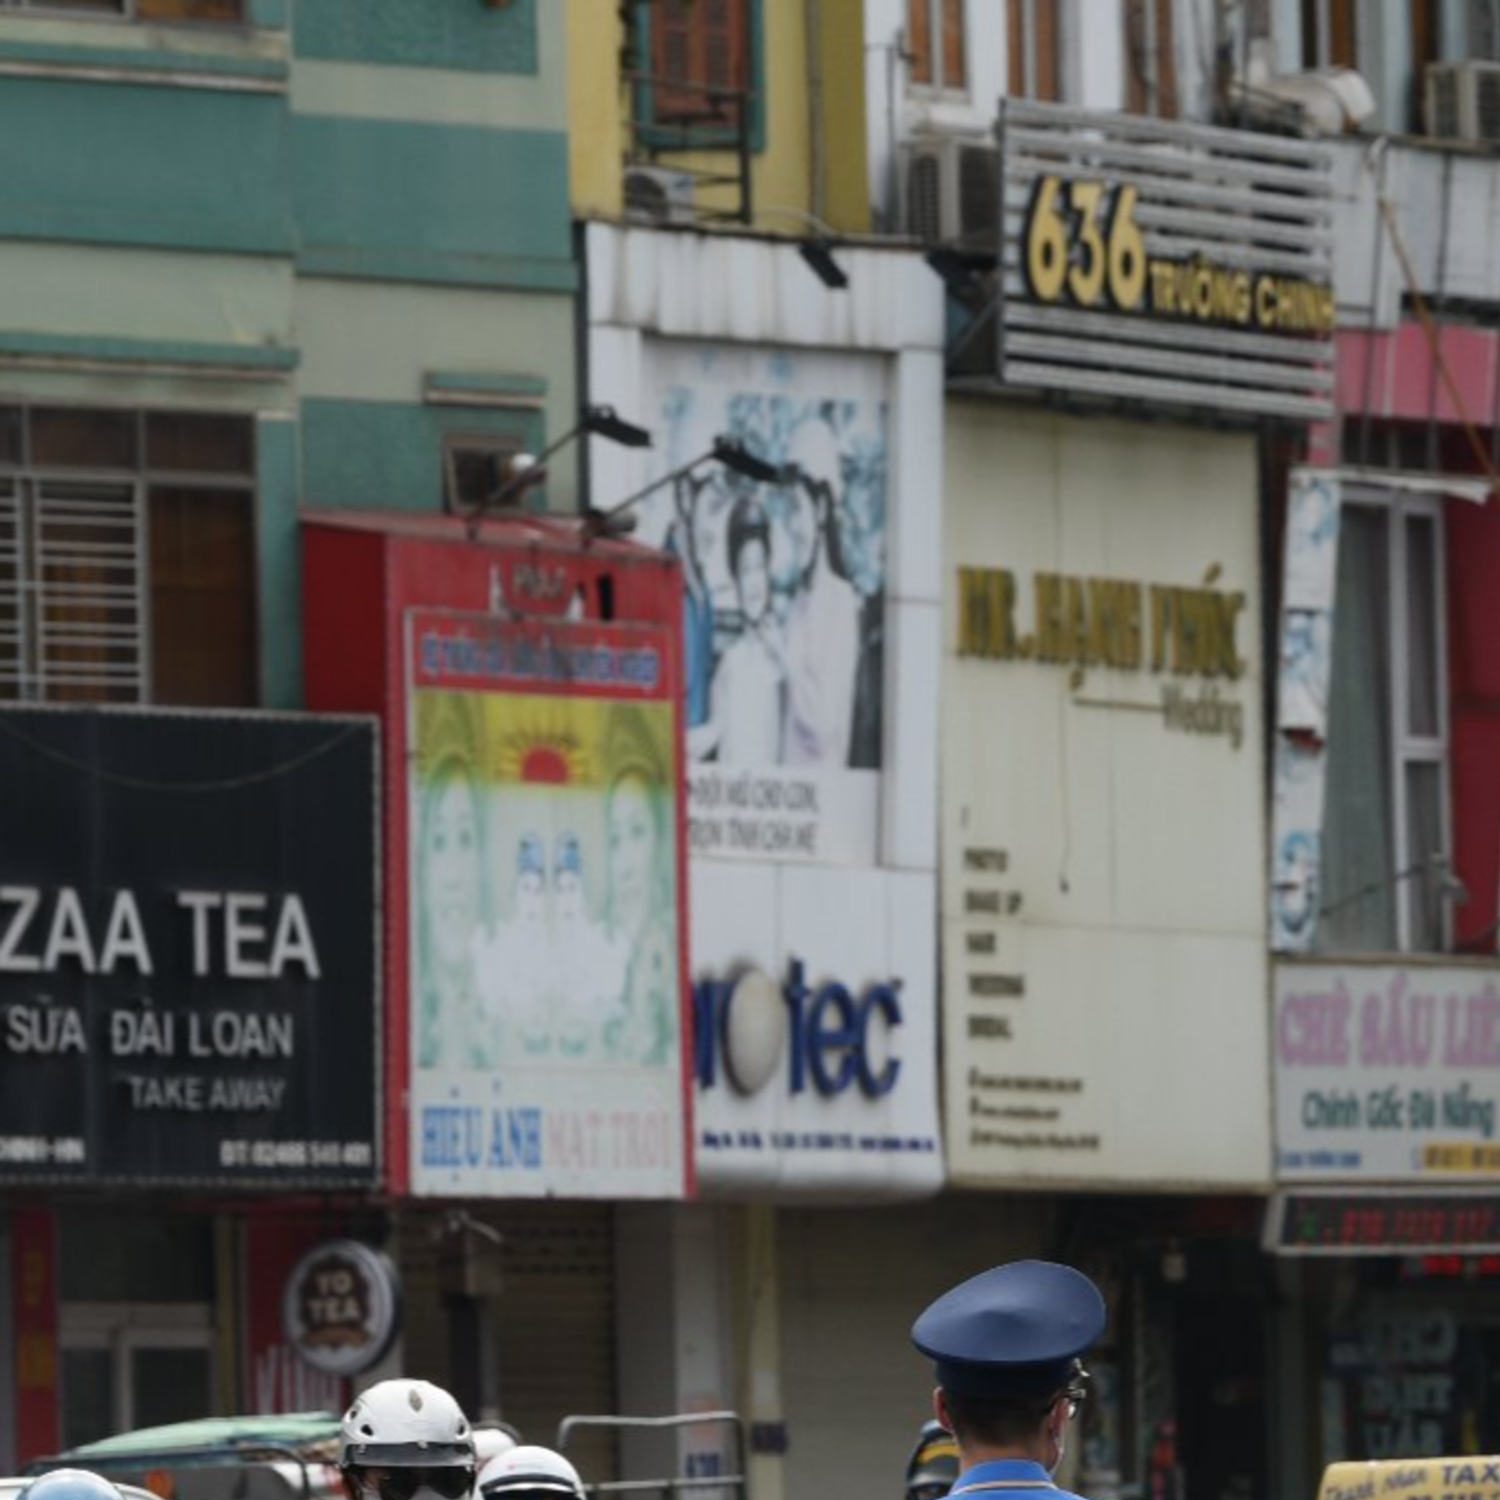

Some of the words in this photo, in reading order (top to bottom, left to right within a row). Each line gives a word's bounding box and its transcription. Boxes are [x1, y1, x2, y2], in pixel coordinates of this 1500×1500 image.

[1029, 174, 1147, 311] 636
[177, 890, 322, 979] TEA
[6, 994, 87, 1053] SỮA
[110, 998, 175, 1056] ĐÀI
[188, 1011, 295, 1057] LOAN
[130, 1076, 203, 1111] TAKE
[208, 1078, 287, 1112] AWAY
[1302, 1085, 1360, 1130] Chính
